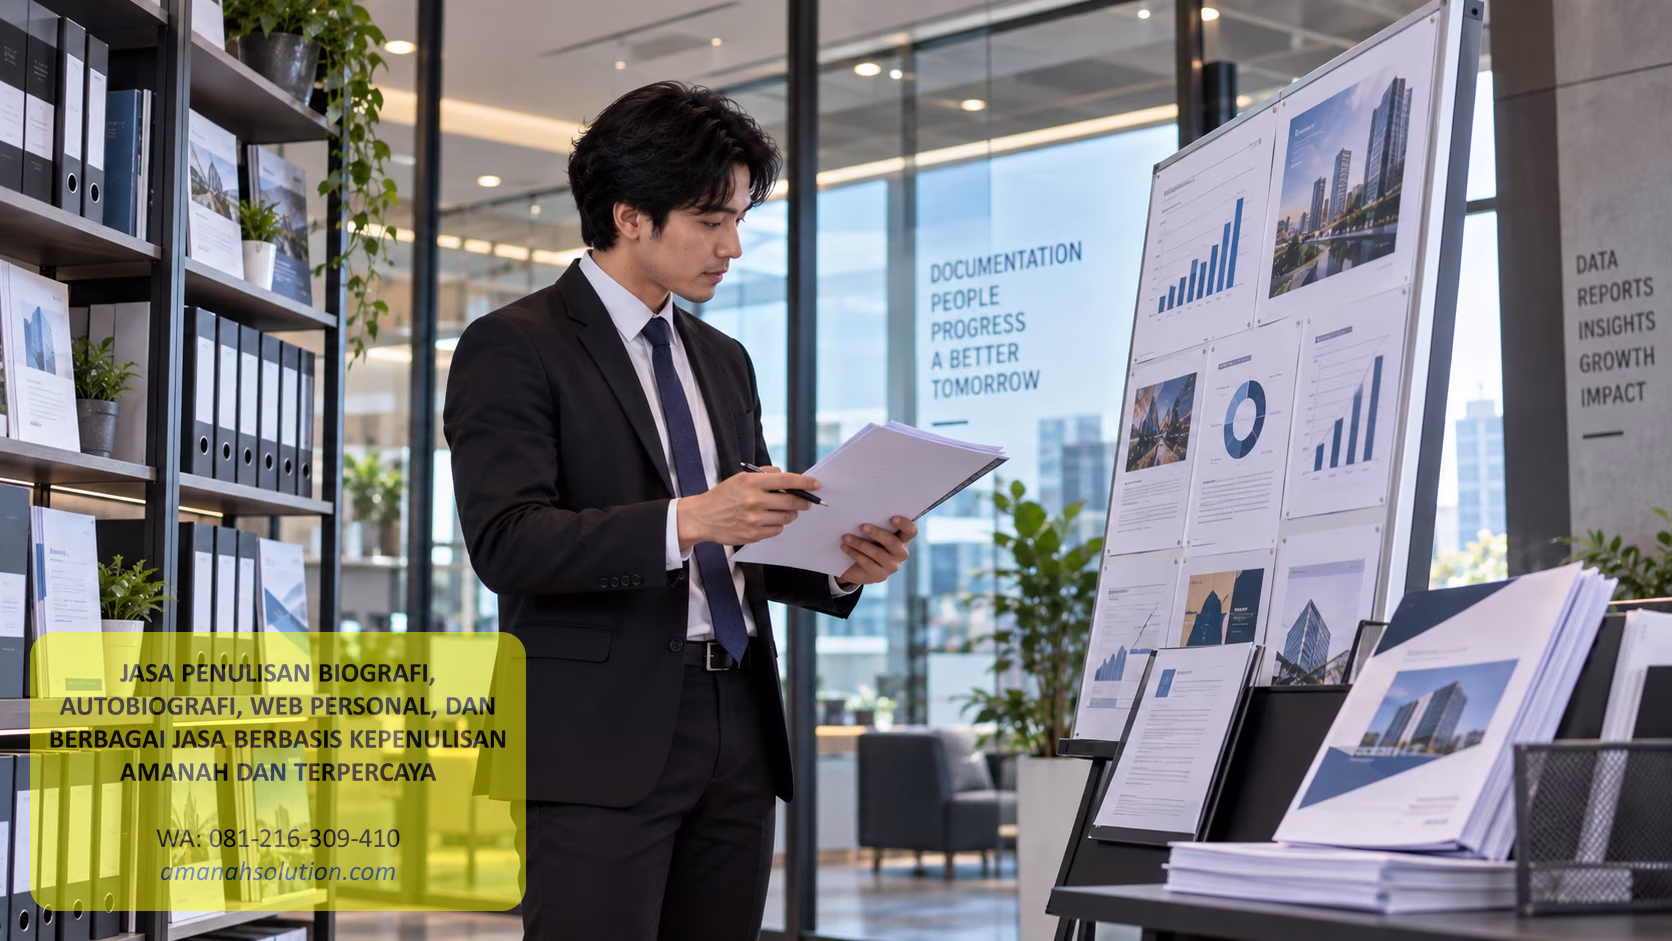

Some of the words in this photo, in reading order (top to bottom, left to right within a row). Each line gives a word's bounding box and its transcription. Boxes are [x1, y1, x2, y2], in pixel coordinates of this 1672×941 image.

[930, 241, 1082, 283] DOCUMENTATION
[1576, 249, 1618, 274] DATA
[931, 285, 999, 313] PEOPLE
[1578, 277, 1653, 307] REPORTS
[931, 312, 1026, 342] PROGRESS
[1579, 311, 1656, 340] INSIGHTS
[931, 352, 942, 370] A
[950, 343, 1019, 369] BETTER
[1580, 346, 1655, 373] GROWTH
[931, 370, 1040, 399] TOMORROW
[1581, 381, 1646, 408] IMPACT
